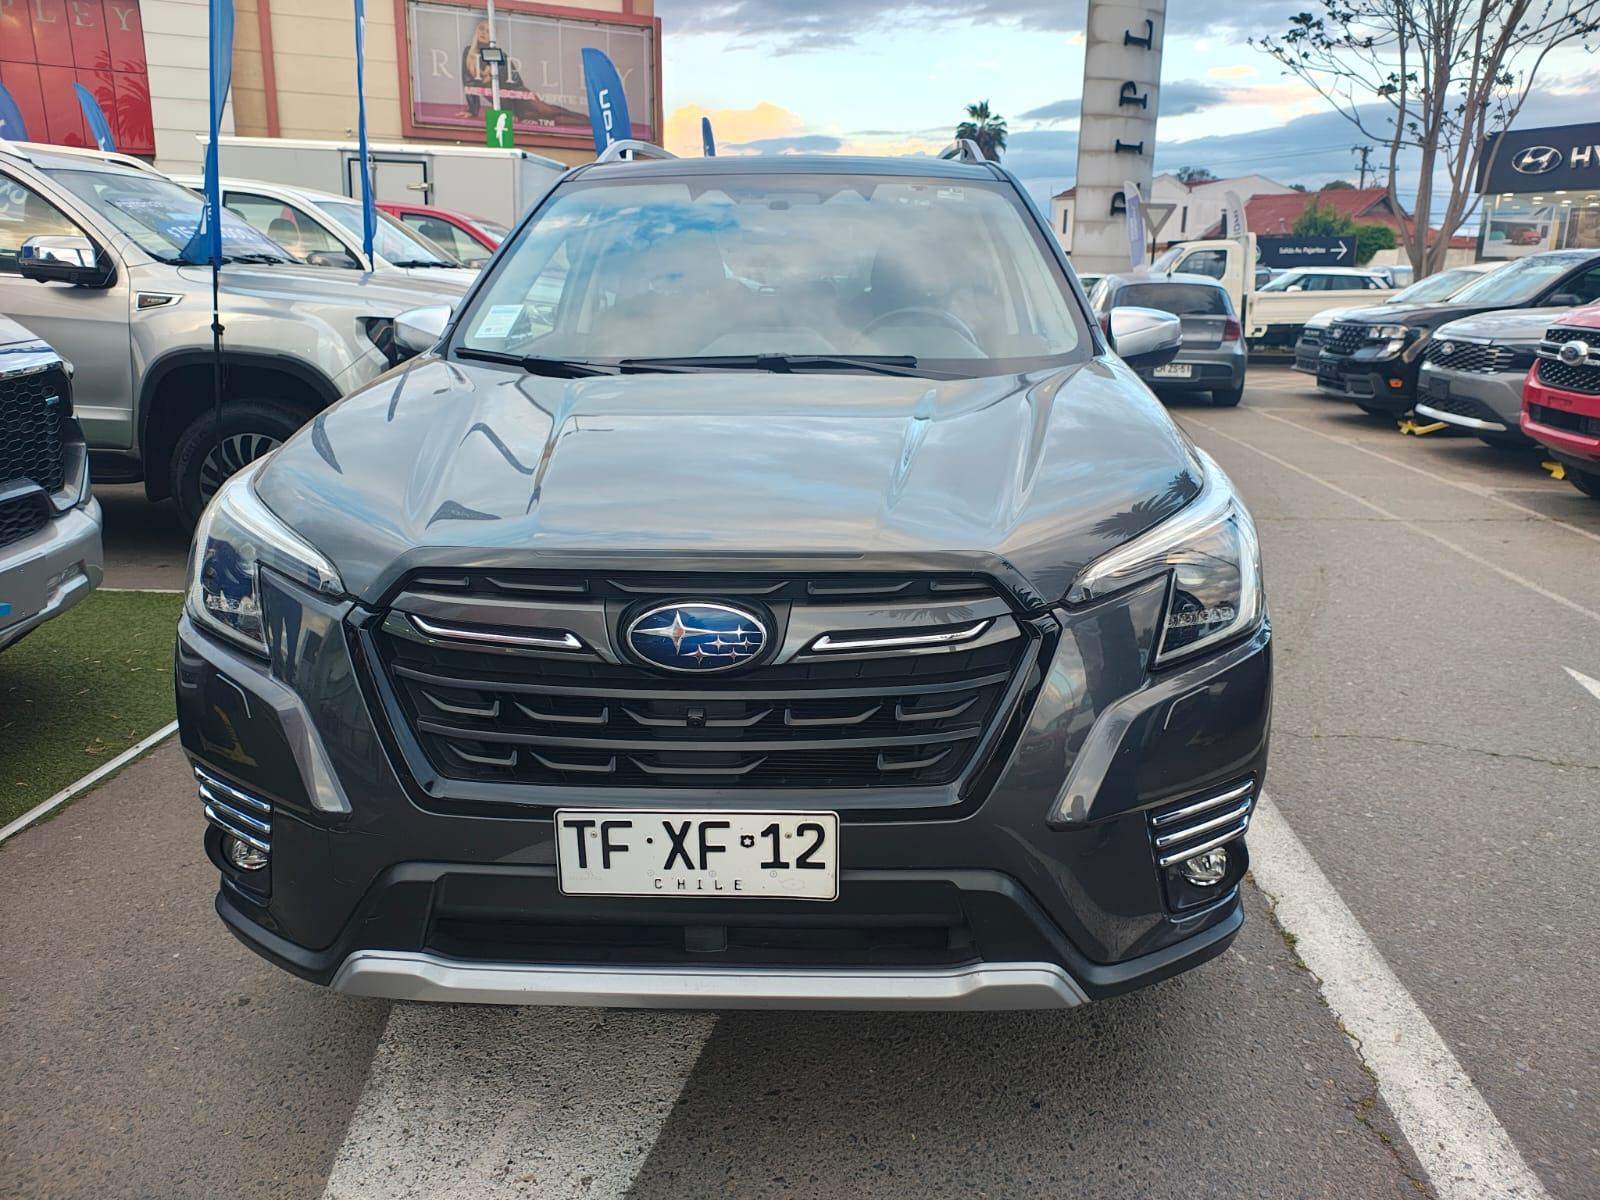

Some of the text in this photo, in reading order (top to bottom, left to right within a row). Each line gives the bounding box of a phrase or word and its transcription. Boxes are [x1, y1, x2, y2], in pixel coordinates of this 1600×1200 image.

[563, 820, 826, 870] TF XF 12
[654, 878, 742, 891] CHILE
